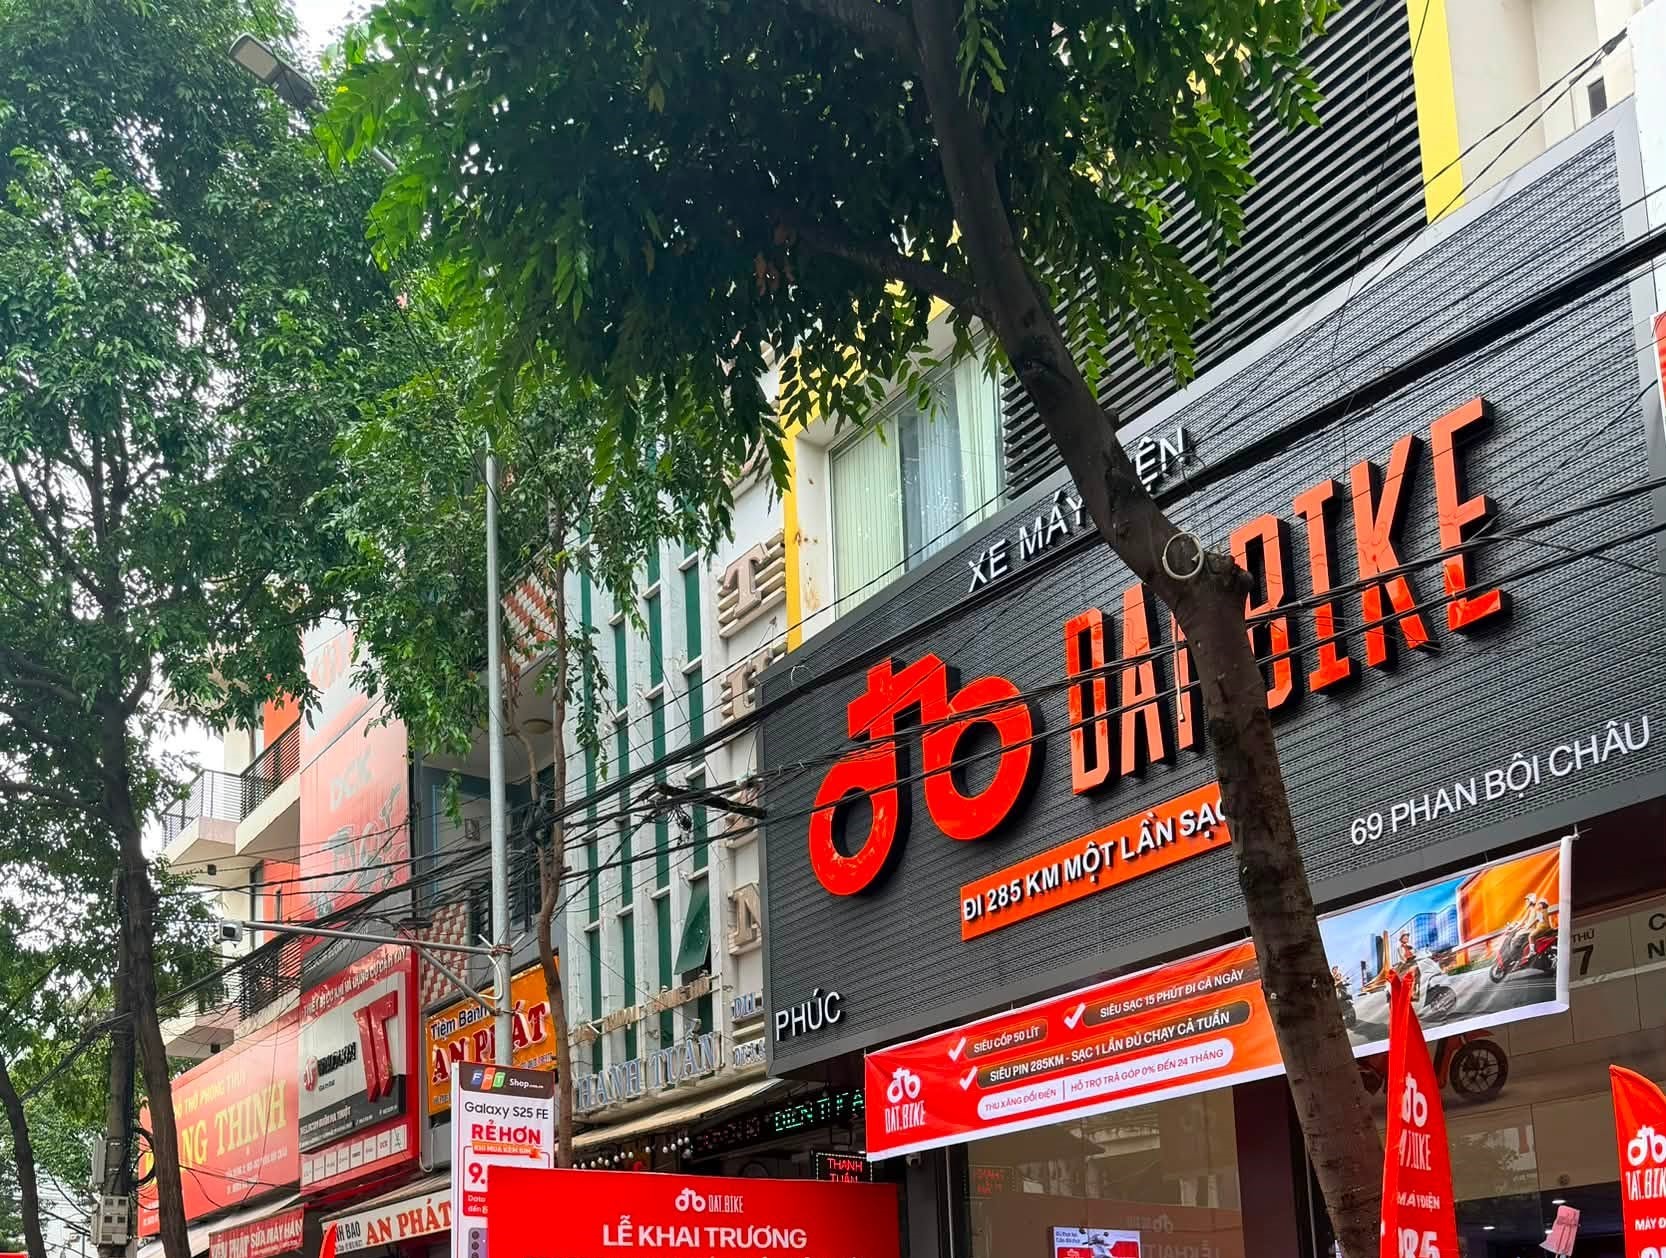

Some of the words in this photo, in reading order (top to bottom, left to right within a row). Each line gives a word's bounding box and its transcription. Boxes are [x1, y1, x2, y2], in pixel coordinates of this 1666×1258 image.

[968, 538, 1008, 593] XE
[1018, 489, 1086, 561] MÁY
[1134, 427, 1186, 492] ỆN
[1350, 815, 1382, 846] 69
[1391, 777, 1478, 832] PHAN
[1485, 752, 1540, 801] BỘI
[1549, 716, 1651, 777] CHÂU
[963, 894, 982, 920] ĐI
[988, 878, 1021, 911] 285
[1026, 864, 1060, 897] KM
[1063, 841, 1115, 882] MỘT
[1120, 812, 1173, 860] LẦN
[1573, 944, 1594, 975] 7
[1100, 1001, 1121, 1018] SIÊU
[1124, 997, 1143, 1013] SẠC
[1145, 995, 1155, 1006] 15
[1157, 985, 1184, 1003] PHÚT
[1185, 982, 1196, 996] ĐI
[1197, 978, 1213, 993] CẢ
[1215, 969, 1244, 987] NGÀY
[775, 986, 842, 1041] PHÚC
[432, 1036, 469, 1084] AN
[472, 1000, 549, 1064] PÁT
[973, 1037, 993, 1054] SIÊU
[994, 1031, 1013, 1050] CỐP
[1014, 1032, 1025, 1044] 50
[1026, 1026, 1040, 1040] LÍT
[990, 1064, 1011, 1082] SIÊU
[1012, 1062, 1030, 1077] PIN
[1030, 1054, 1064, 1075] 285KM
[1071, 1045, 1095, 1064] SẠC
[1101, 1033, 1125, 1056] LẦN
[1125, 1030, 1142, 1048] ĐỦ
[1143, 1024, 1175, 1044] CHẠY
[1177, 1017, 1195, 1036] CẢ
[1141, 1064, 1156, 1076] 0%
[1178, 1057, 1189, 1068] 24
[1190, 1048, 1225, 1067] THÁNG
[471, 1067, 506, 1090] FPT
[577, 1057, 642, 1110] HANH
[464, 1101, 511, 1119] Galaxy
[513, 1106, 533, 1119] S25
[536, 1108, 549, 1120] FE
[984, 1100, 1001, 1113] THU
[471, 1119, 497, 1141] RẺ
[499, 1125, 541, 1145] HƠN
[827, 1157, 863, 1173] THANH
[708, 1194, 744, 1213] DAT.BIKE
[345, 1220, 361, 1240] BAO
[366, 1216, 393, 1246] AN
[396, 1198, 453, 1238] PHÁT
[602, 1214, 634, 1246] LỄ
[638, 1225, 700, 1248] KHAI
[703, 1224, 808, 1249] TRƯƠNG
[1634, 1216, 1657, 1231] MÁY
